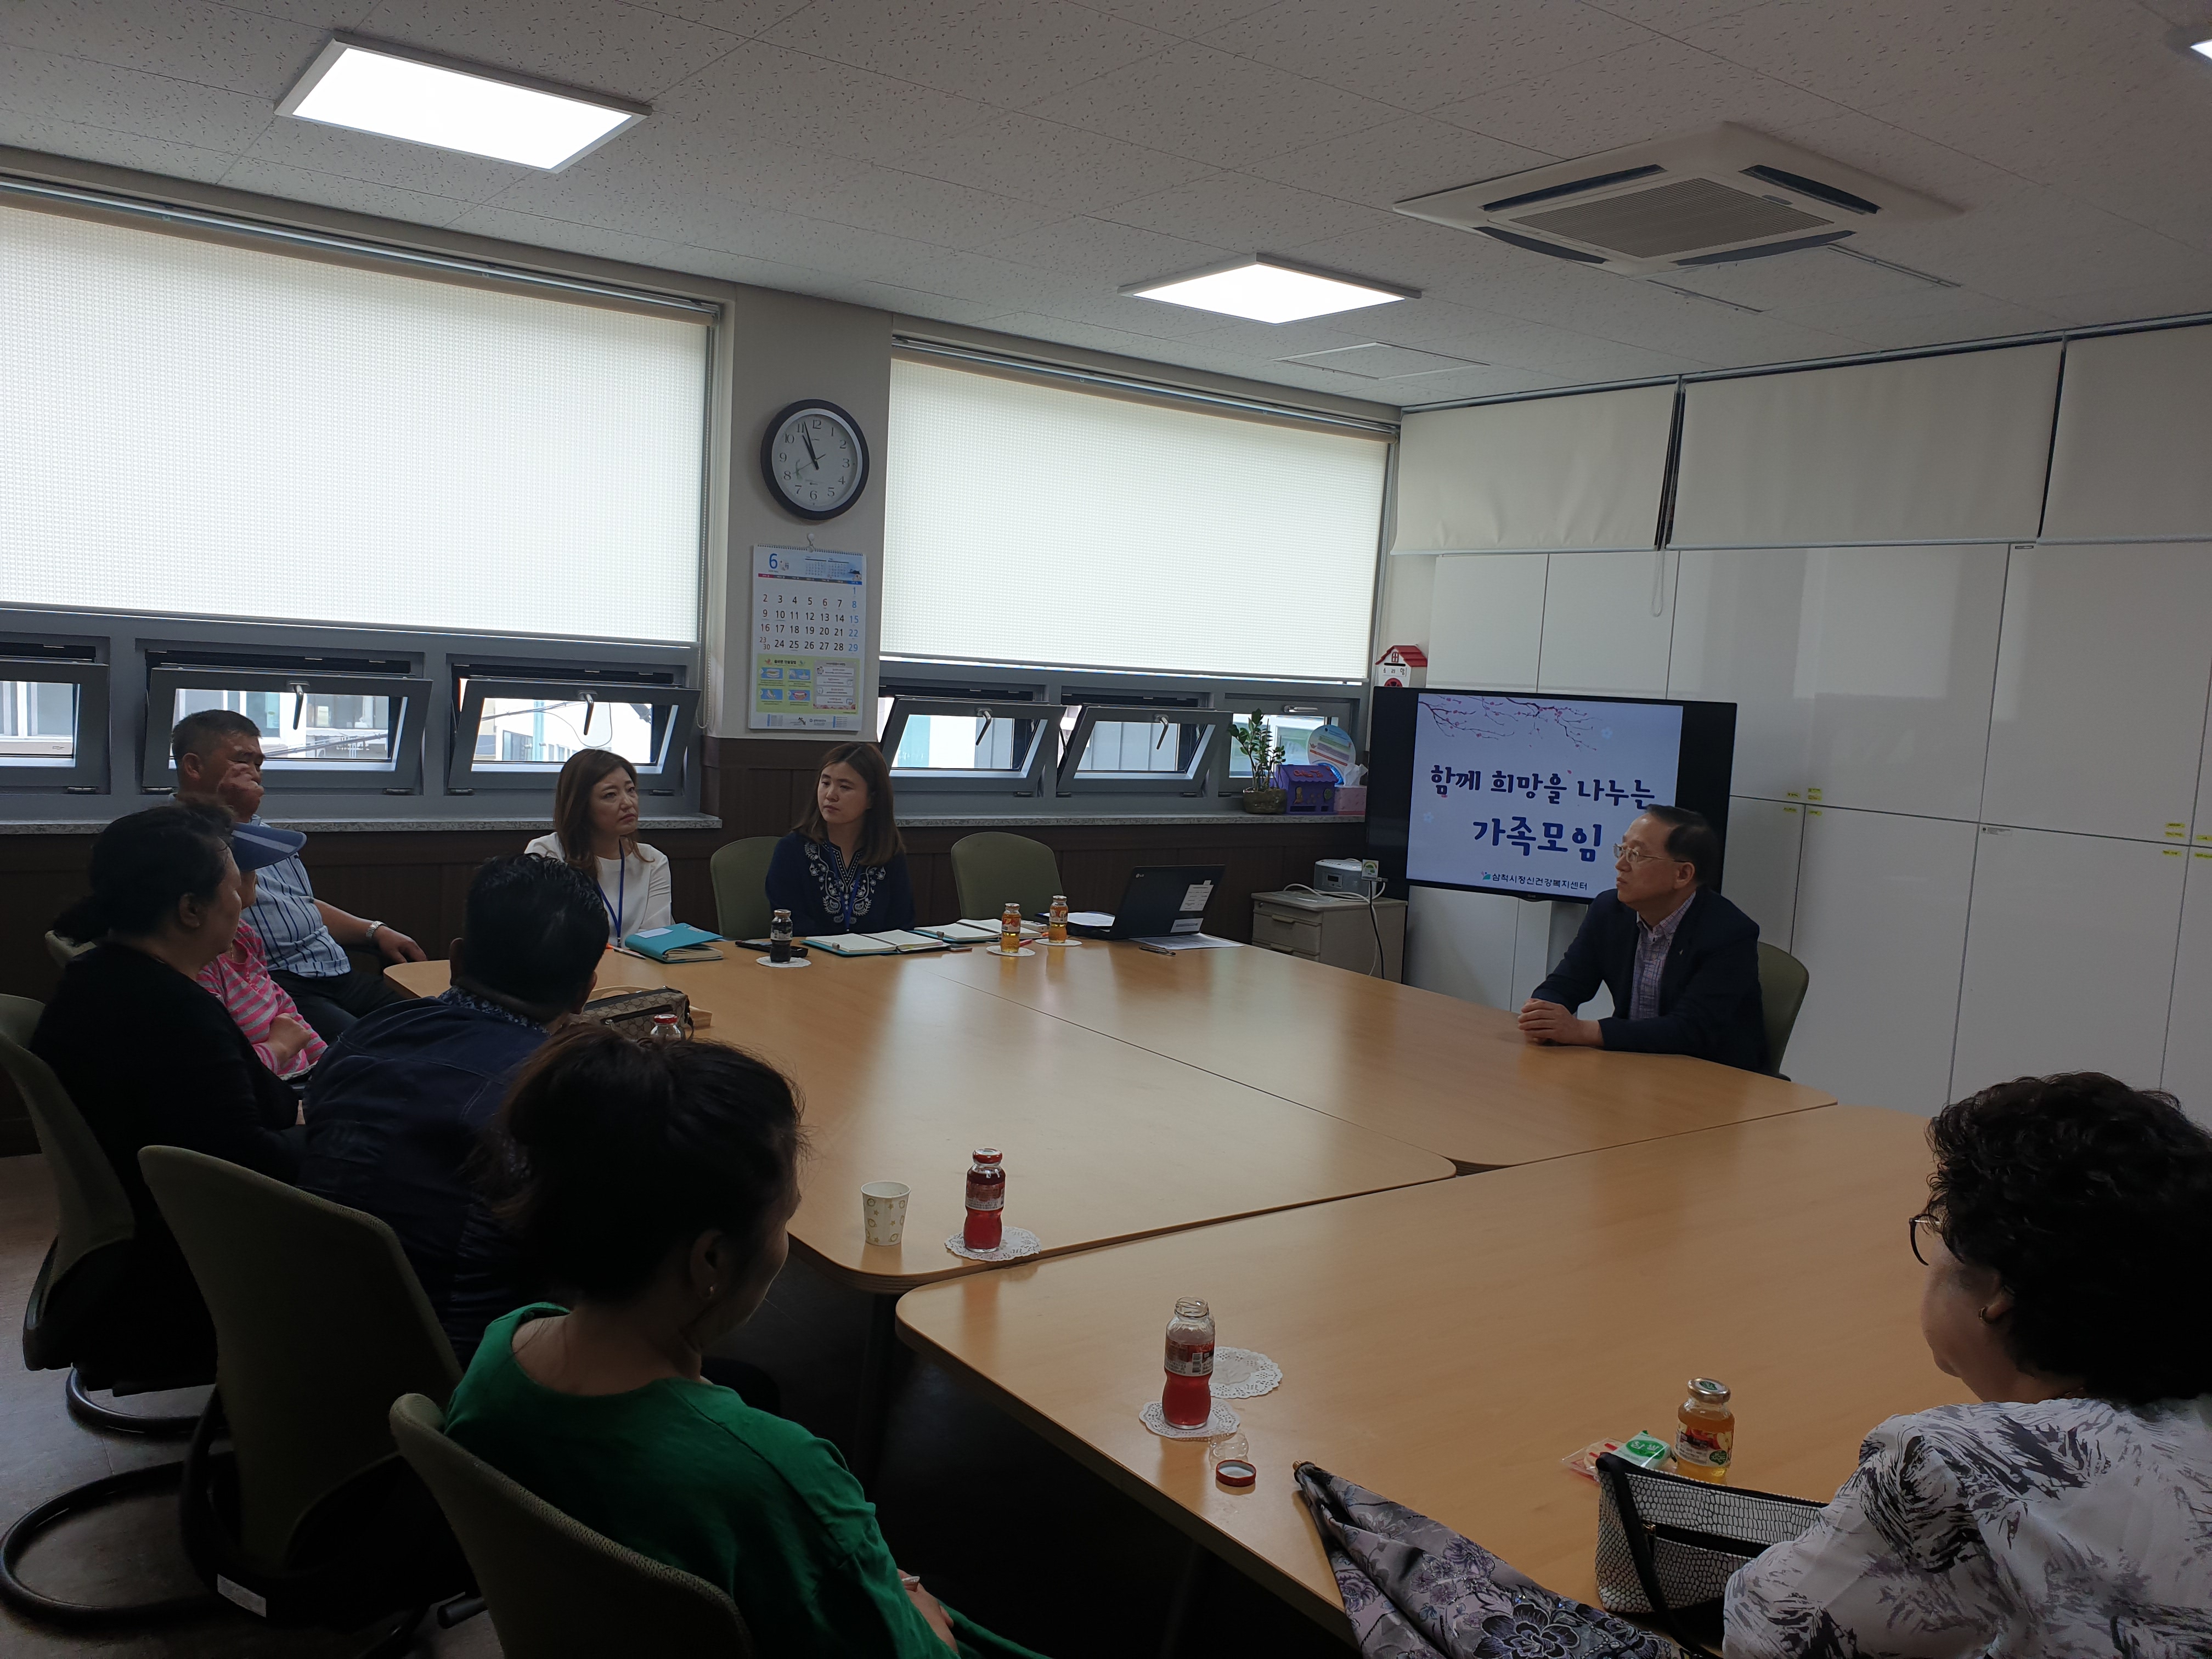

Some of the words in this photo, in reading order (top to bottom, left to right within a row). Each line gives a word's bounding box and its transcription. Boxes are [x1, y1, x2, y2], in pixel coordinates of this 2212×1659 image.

[798, 424, 804, 432] 11
[812, 420, 822, 429] 12
[785, 435, 794, 443] 10
[840, 440, 847, 449] 2
[780, 453, 787, 462] 9
[842, 459, 850, 467] 3
[784, 471, 791, 481] 8
[838, 476, 845, 484] 4
[795, 485, 802, 494] 7
[827, 487, 834, 497] 5
[810, 490, 817, 500] 6
[769, 554, 777, 569] 6
[775, 640, 784, 648] 24
[1430, 765, 1481, 794] 함께
[1491, 771, 1567, 804] 희망을
[1578, 780, 1655, 810] 나누는
[1473, 816, 1602, 862] 가족모임
[1493, 873, 1587, 890] 삼척시정신건강복지센터
